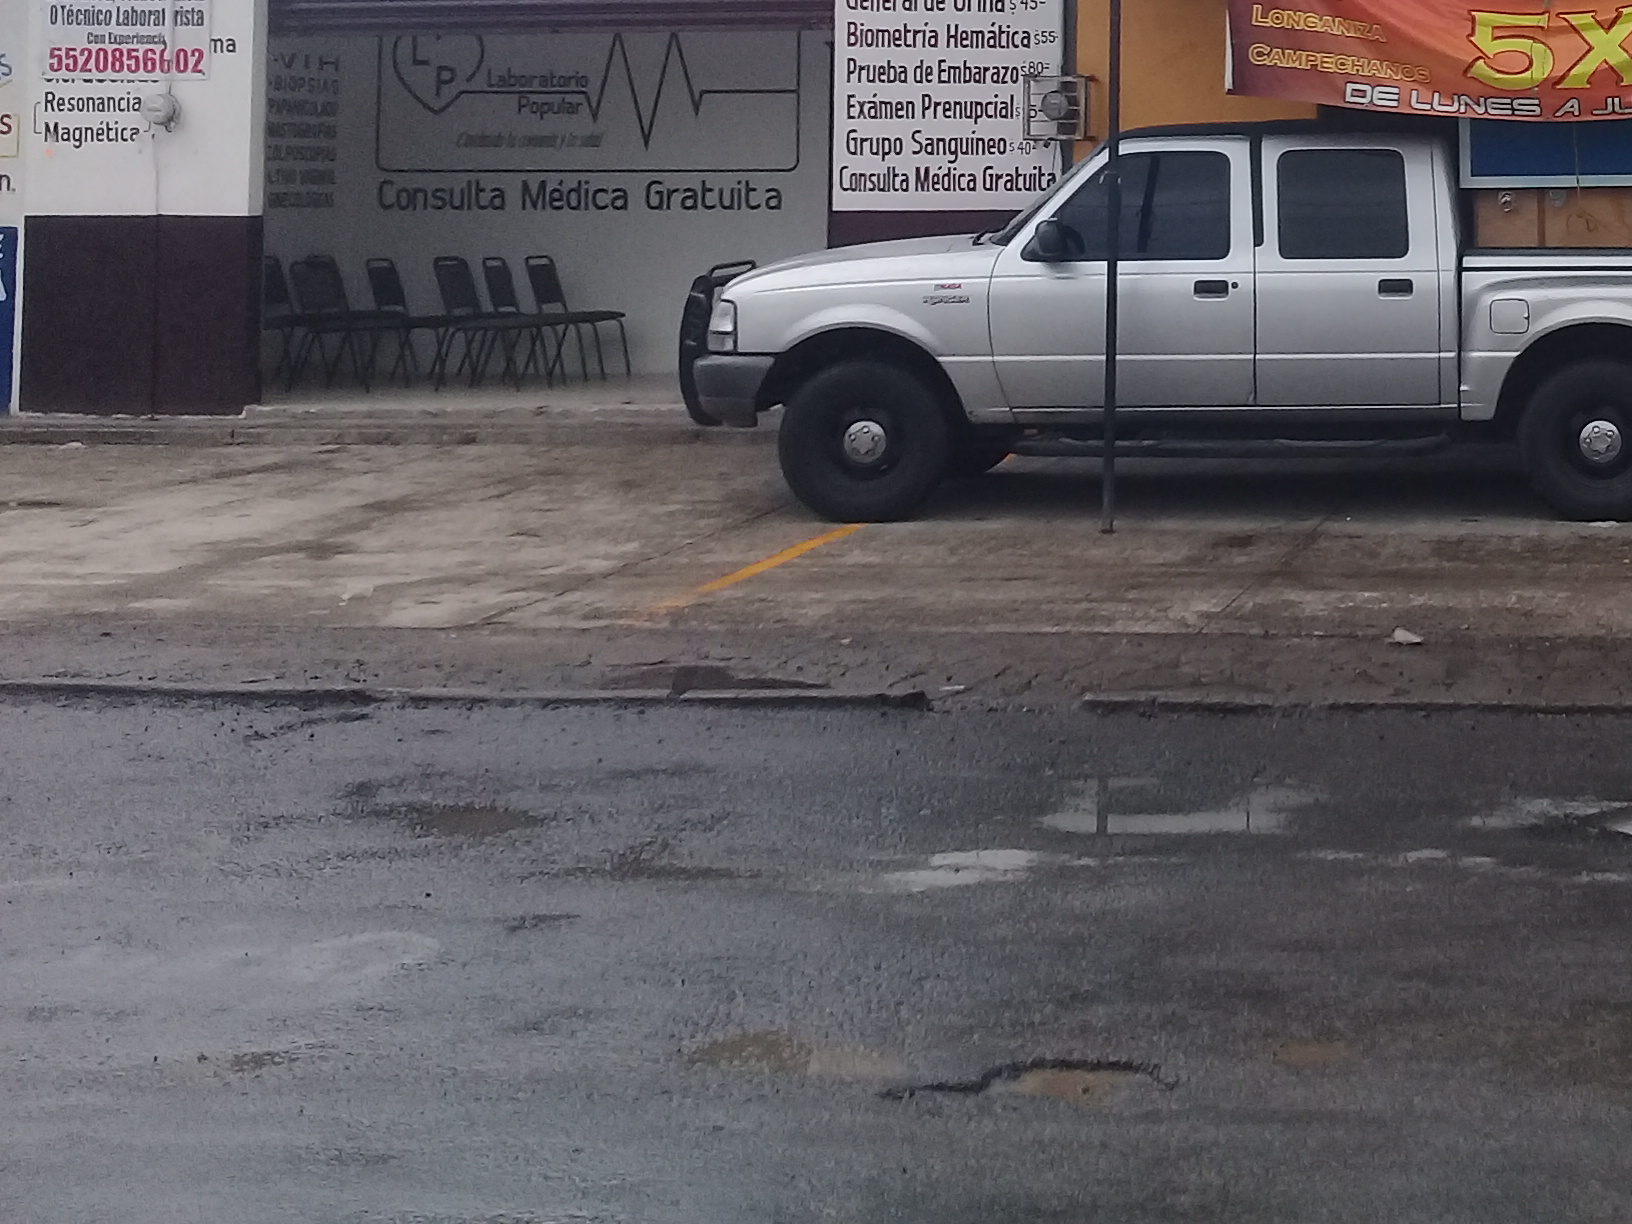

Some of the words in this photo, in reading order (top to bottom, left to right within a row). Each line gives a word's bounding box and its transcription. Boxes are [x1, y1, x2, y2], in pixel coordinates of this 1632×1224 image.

[846, 21, 938, 48] Biometría
[946, 24, 1030, 49] Hemática
[846, 58, 907, 84] Prueba
[913, 59, 933, 83] de
[937, 59, 1019, 84] Embarazo
[1248, 43, 1432, 83] CAMPECHANOS
[486, 69, 589, 89] Laboratorio
[44, 91, 142, 112] Resonancia
[518, 96, 583, 119] Popular
[846, 93, 915, 120] Exámen
[921, 94, 1014, 124] Prenupcial
[1344, 82, 1401, 106] DE
[1410, 90, 1541, 117] LUNES
[1554, 102, 1581, 117] A
[44, 121, 140, 149] Magnética
[845, 129, 903, 161] Grupo
[911, 130, 1007, 163] Sanguíneo
[839, 165, 910, 192] Consulta
[915, 166, 977, 193] Médica
[982, 167, 1056, 192] Gratuita
[378, 181, 505, 211] Consulta
[521, 178, 629, 211] Médica
[645, 181, 782, 211] Gratuita
